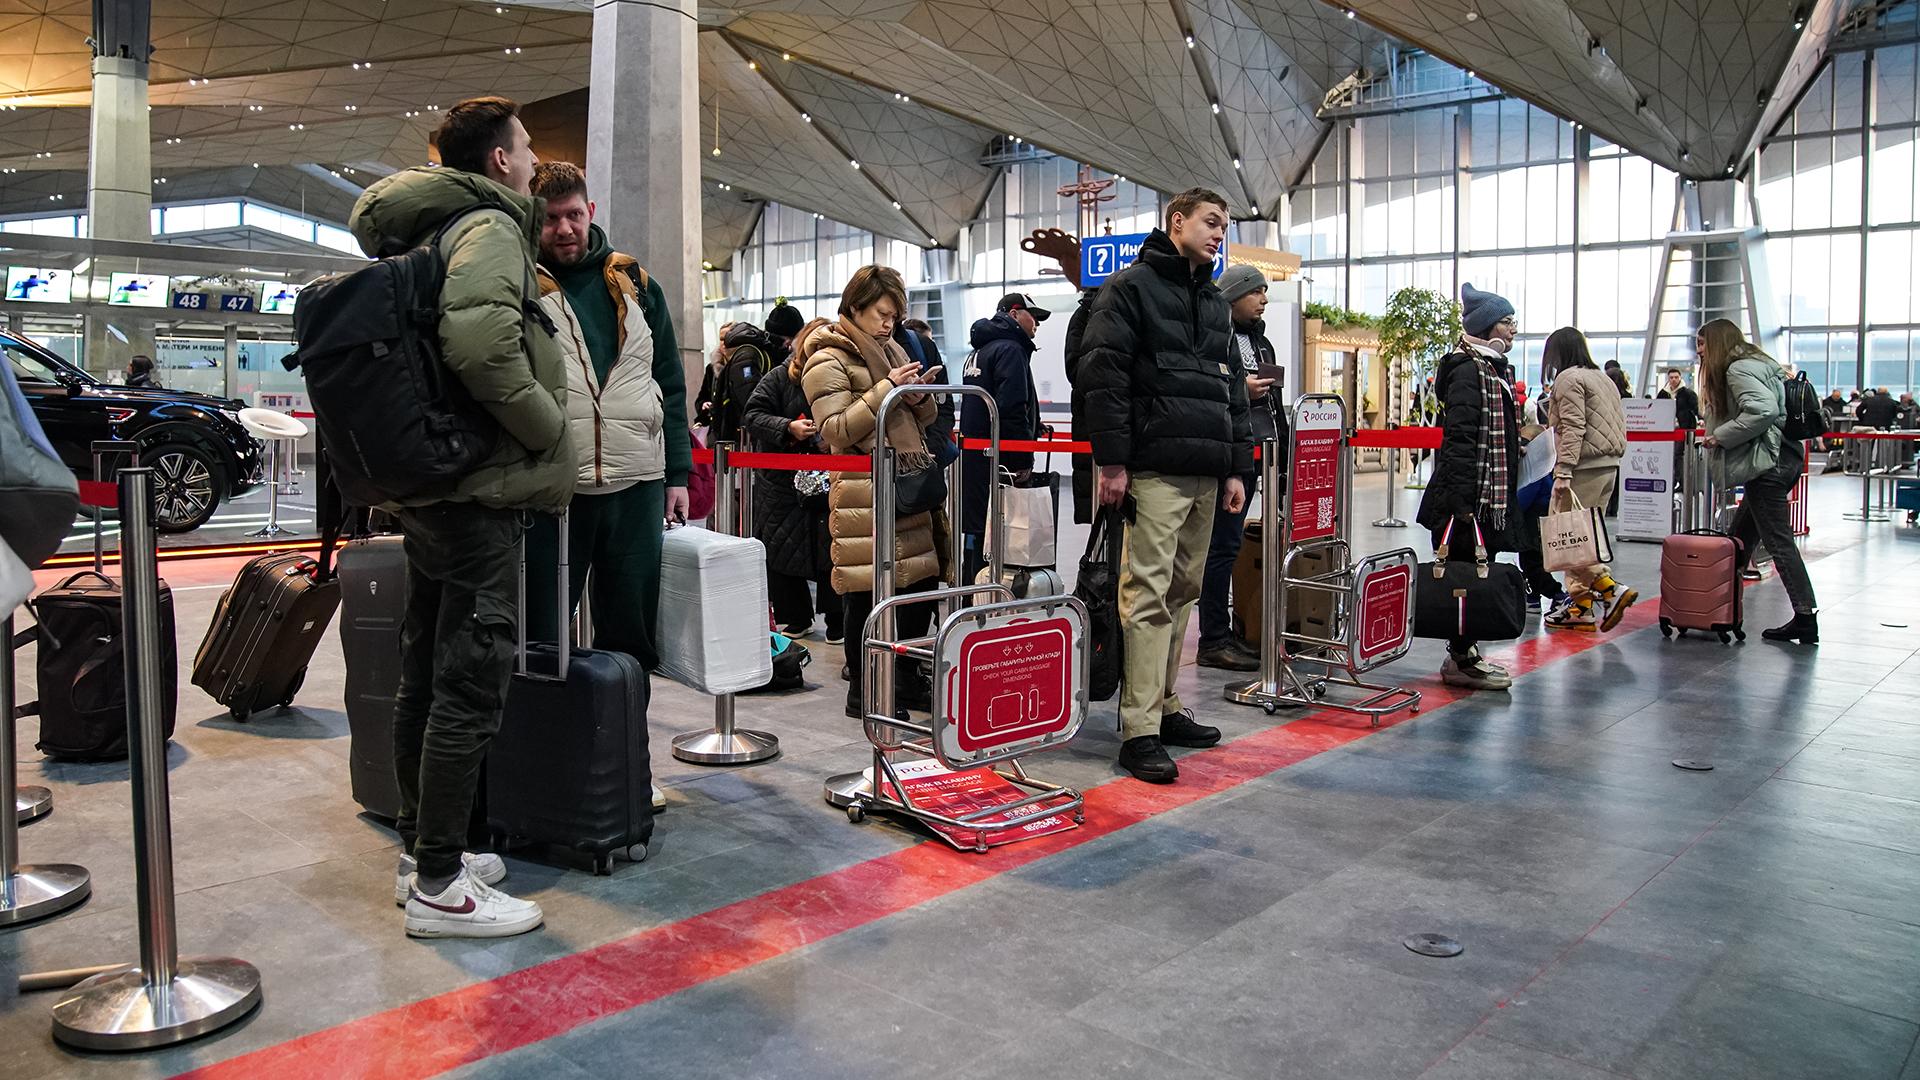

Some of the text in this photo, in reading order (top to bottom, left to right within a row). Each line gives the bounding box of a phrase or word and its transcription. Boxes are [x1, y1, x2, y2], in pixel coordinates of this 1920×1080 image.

[179, 295, 200, 308] 48
[227, 297, 248, 310] 47
[1310, 412, 1337, 421] РОССИЯ
[1547, 540, 1567, 548] TOTE
[1569, 536, 1589, 544] BAG
[972, 651, 1061, 672] ПРОВЕРЬТЕ ГАБАРИТЫ РУЧНОЙ КЛАДИ
[983, 662, 1051, 681] CHECK YOUR CABIN BAGGAGE
[1003, 673, 1032, 683] DIMENSIONS
[900, 764, 939, 774] РОСС
[905, 782, 933, 790] АГАЖ
[943, 774, 981, 784] КАБИНУ
[907, 780, 984, 794] CABIN BAGGAGE
